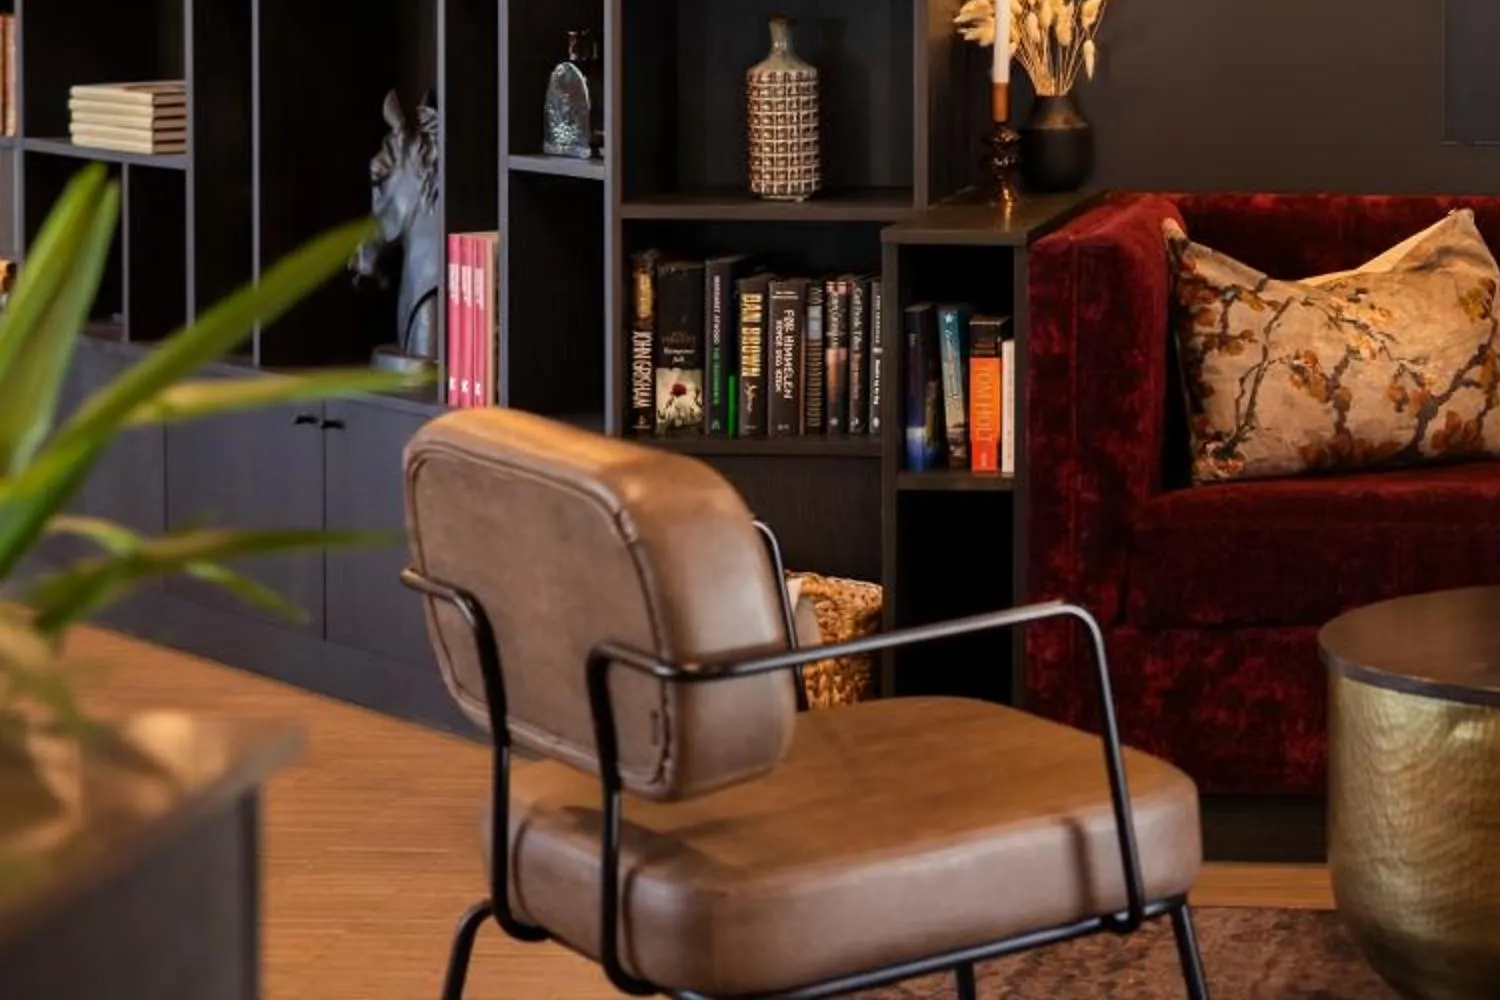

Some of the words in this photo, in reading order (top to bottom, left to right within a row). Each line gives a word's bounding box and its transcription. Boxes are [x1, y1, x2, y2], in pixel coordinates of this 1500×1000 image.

[741, 294, 763, 323] DAN
[632, 331, 652, 359] JOHN
[741, 327, 763, 377] BROWN
[784, 335, 795, 399] HIMMELEN
